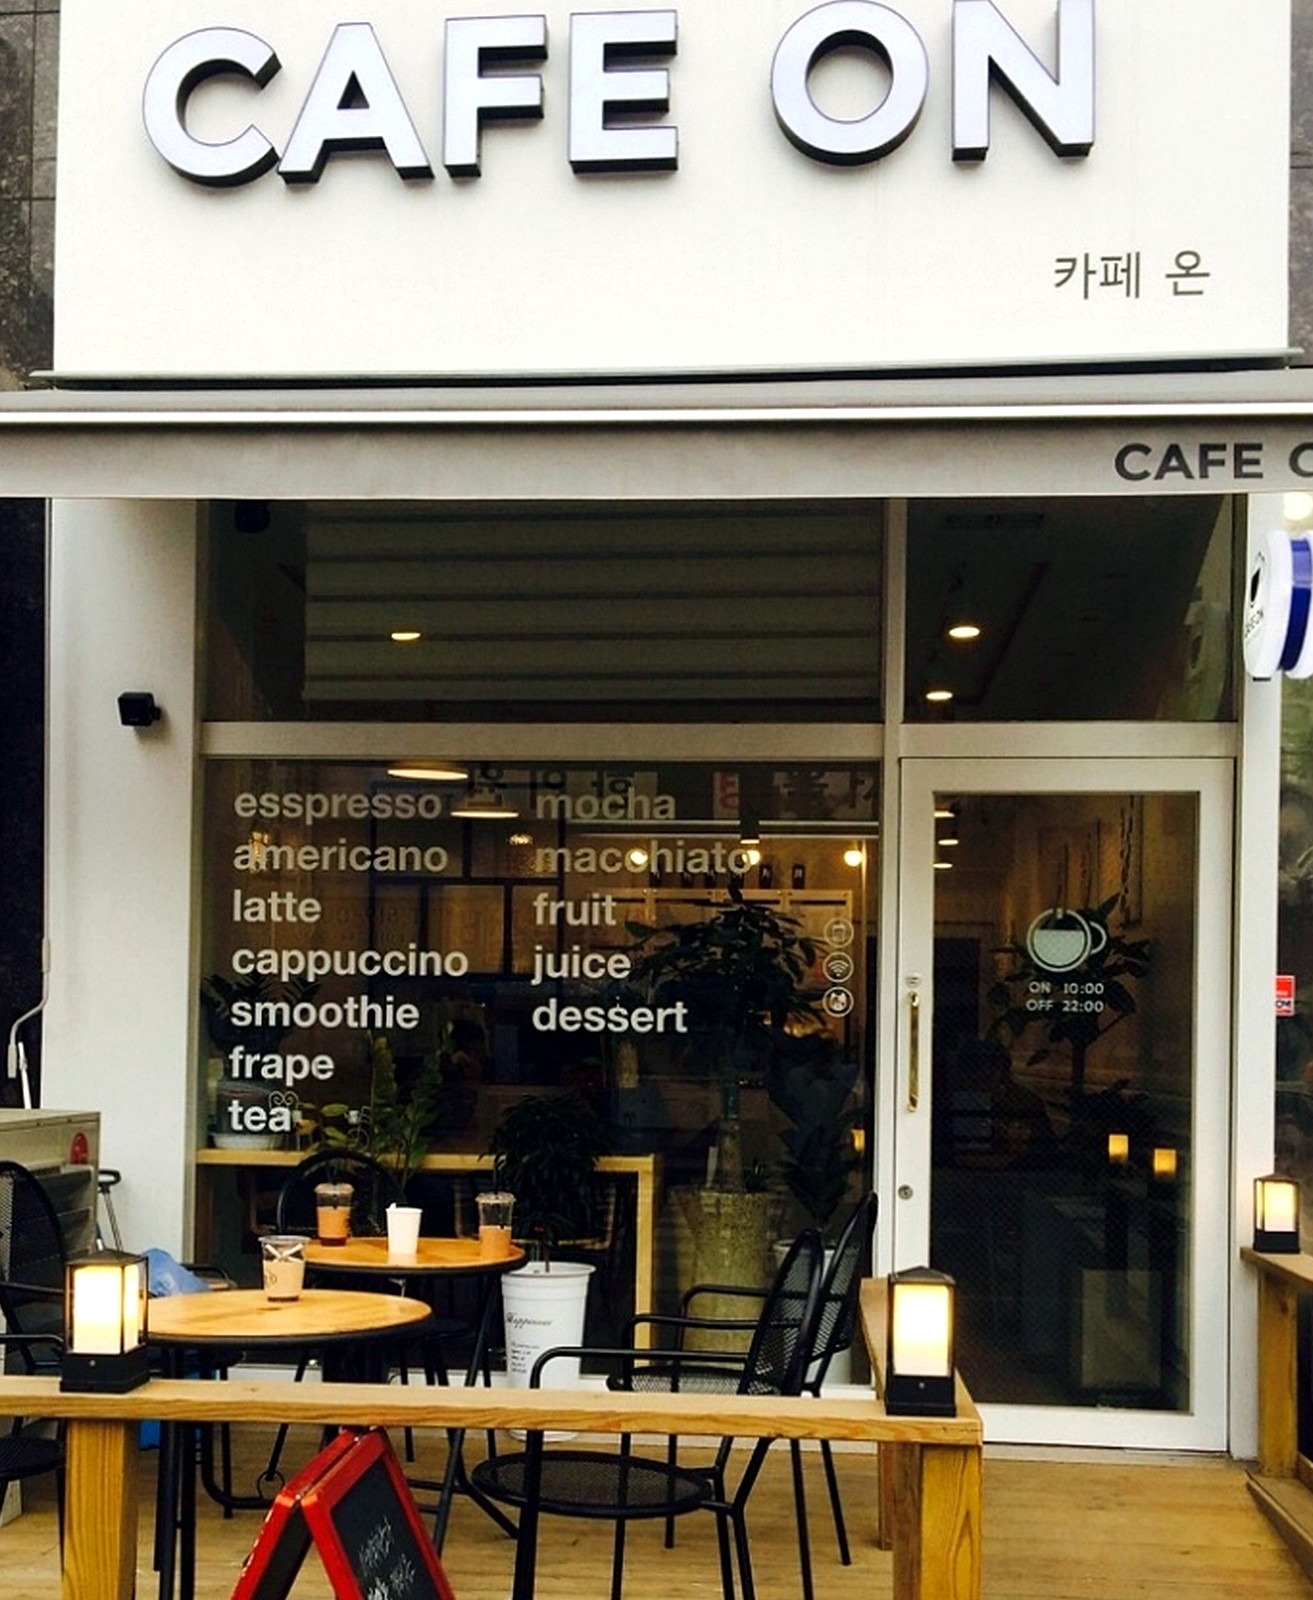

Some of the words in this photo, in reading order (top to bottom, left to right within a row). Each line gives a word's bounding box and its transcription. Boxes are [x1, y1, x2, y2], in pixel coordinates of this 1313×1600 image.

[142, 9, 679, 188] CAFE
[771, 0, 1096, 167] ON
[1054, 251, 1142, 300] 카페
[1165, 250, 1211, 296] 온
[1114, 442, 1264, 482] CAFE
[233, 791, 443, 826] esspresso
[535, 786, 677, 820] mocha
[233, 838, 449, 872] americano
[535, 839, 752, 874] macchiato
[232, 888, 323, 923] latte
[533, 892, 617, 926] fruit
[231, 943, 469, 982] cappuccino
[531, 945, 632, 986] juice
[1028, 981, 1052, 994] ON
[1063, 982, 1105, 995] 10:00
[230, 995, 421, 1029] smoothie
[532, 998, 689, 1034] dessert
[1025, 999, 1054, 1012] OFF
[1062, 1000, 1105, 1013] 22:00
[228, 1045, 335, 1087] frape
[228, 1099, 291, 1132] tea
